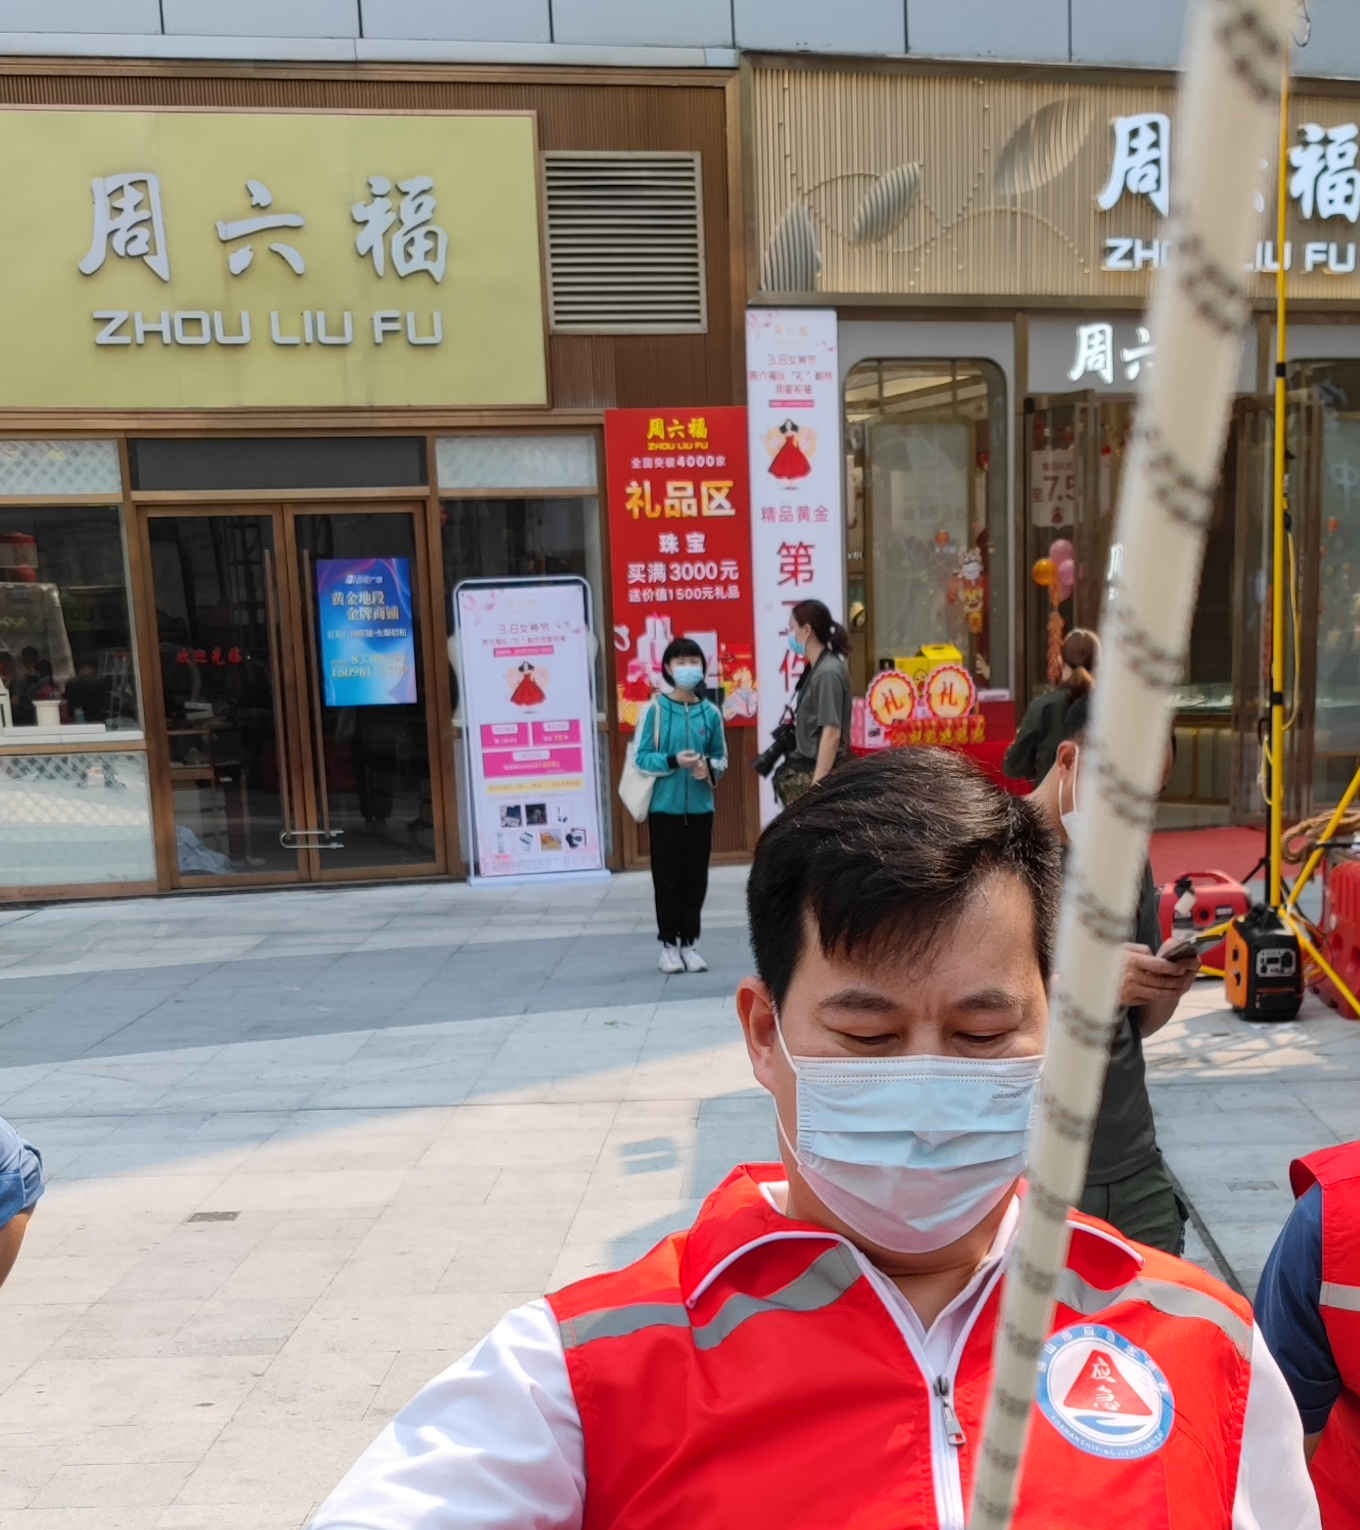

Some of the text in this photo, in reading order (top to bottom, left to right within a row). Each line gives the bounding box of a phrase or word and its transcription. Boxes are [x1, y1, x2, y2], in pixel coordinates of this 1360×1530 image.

[78, 172, 449, 284] 周六福
[1303, 241, 1357, 273] FU
[92, 310, 444, 346] ZHOU LIU FU
[647, 417, 709, 440] 周六福
[647, 441, 709, 451] ZHOU LIU FU
[625, 479, 737, 520] 礼品区
[761, 505, 830, 524] 精品黄金
[658, 531, 706, 554] 珠宝
[627, 560, 739, 584] 买满3000元
